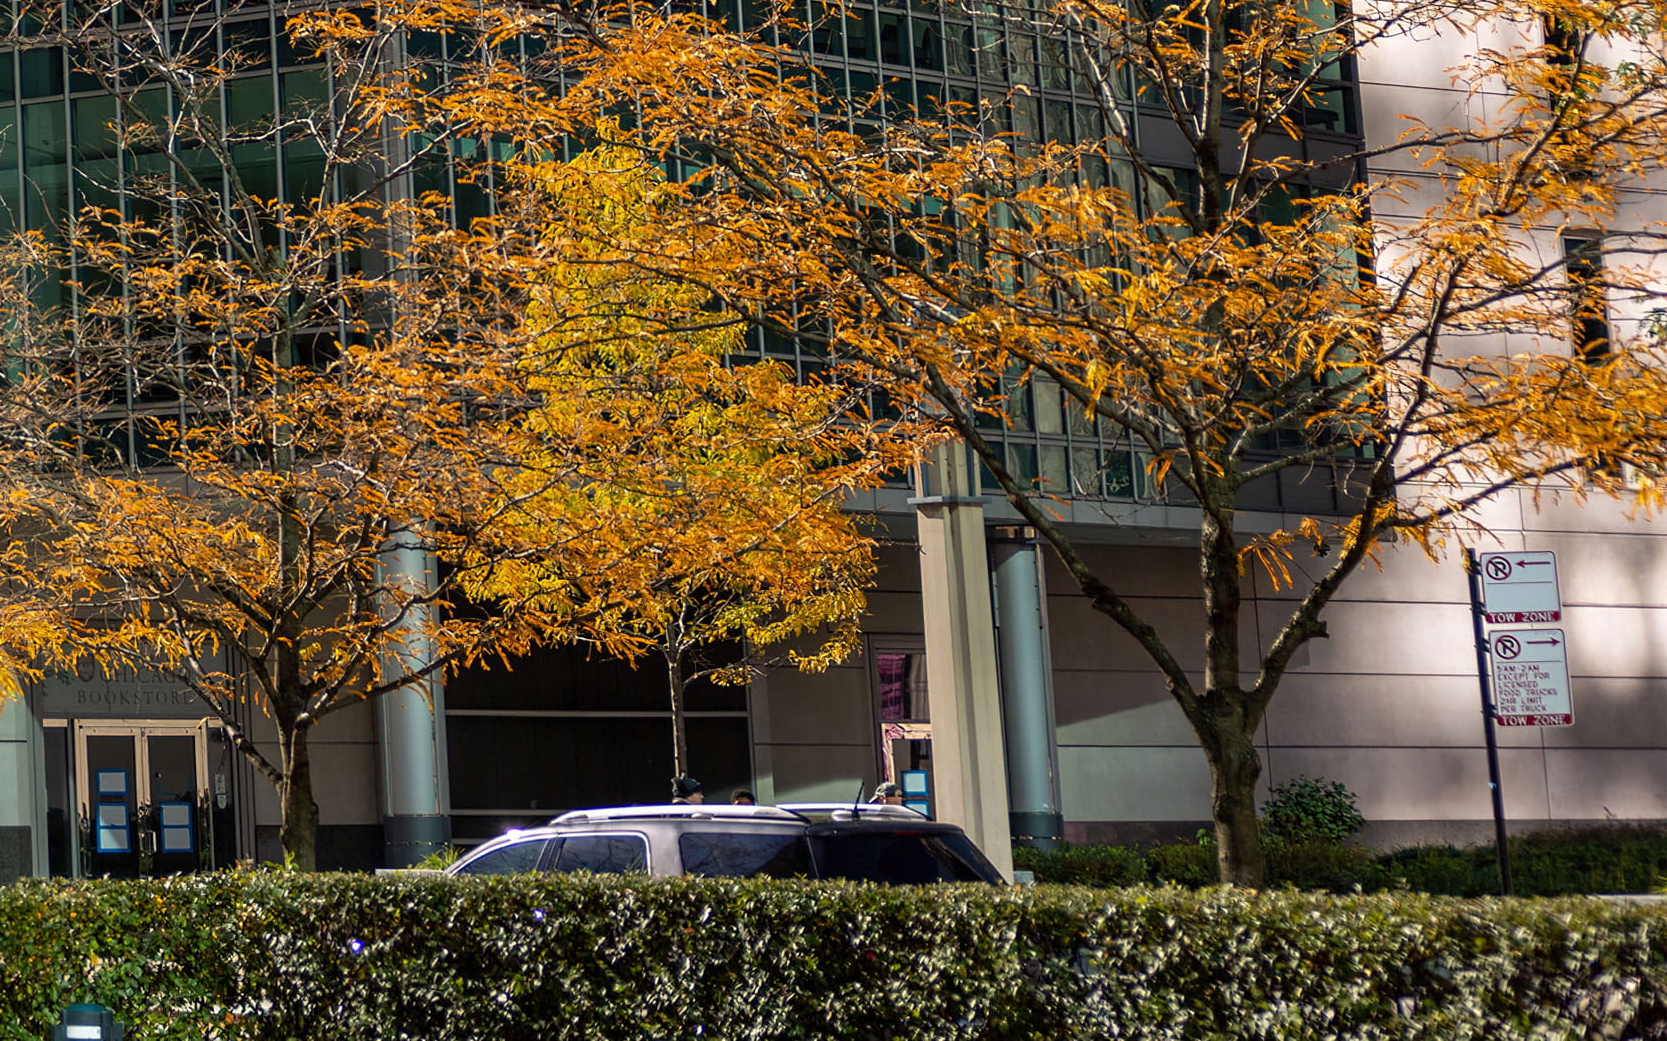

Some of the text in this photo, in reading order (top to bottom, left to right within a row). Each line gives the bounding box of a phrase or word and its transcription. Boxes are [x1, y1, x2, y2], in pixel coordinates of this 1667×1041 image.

[1489, 612, 1554, 623] TOW ZONE
[1497, 672, 1528, 681] EXCEPT
[1498, 681, 1539, 689] LICENSED
[1498, 688, 1558, 697] FOOD TRUCKS
[77, 690, 195, 705] BOOKSTORE
[1521, 696, 1543, 705] LIMIT
[1500, 704, 1547, 713] PER TRUCK
[1502, 715, 1564, 726] TOW ZONE
